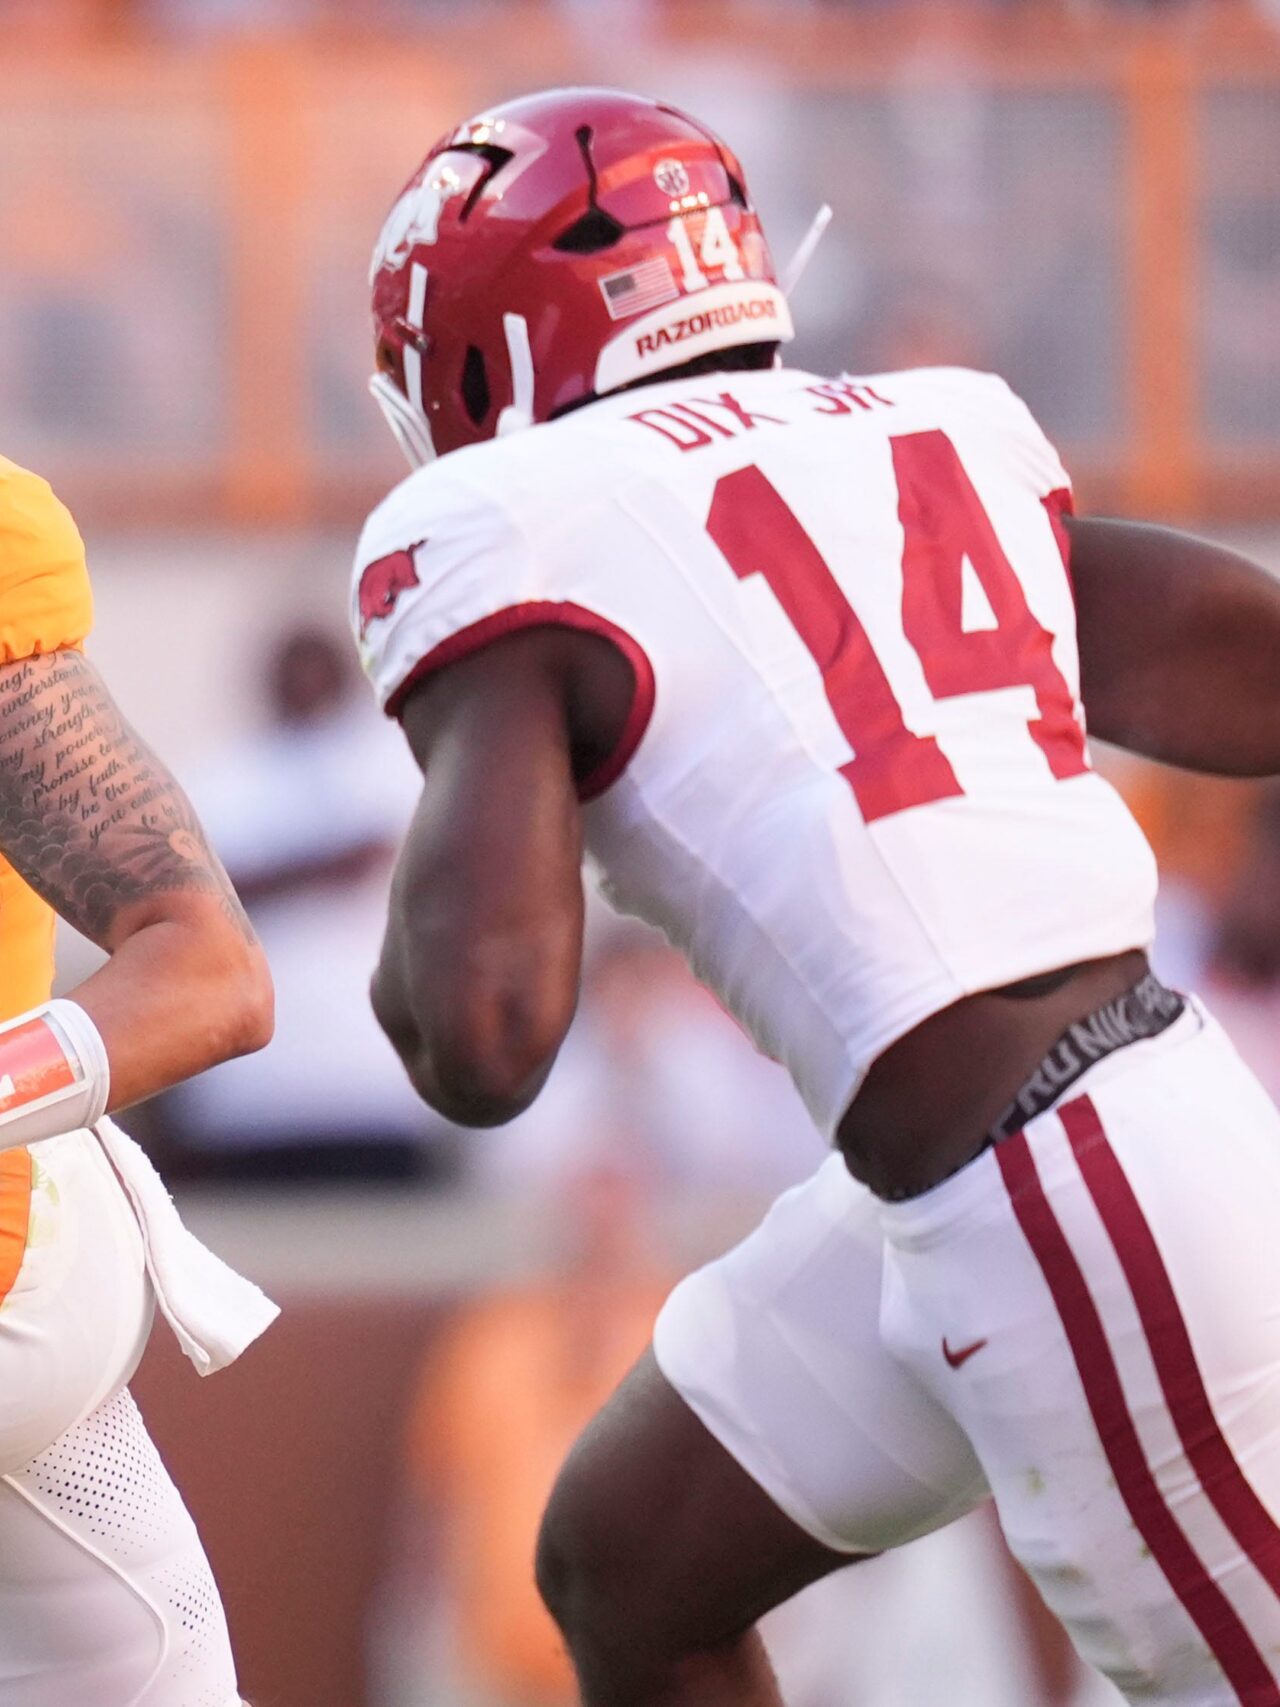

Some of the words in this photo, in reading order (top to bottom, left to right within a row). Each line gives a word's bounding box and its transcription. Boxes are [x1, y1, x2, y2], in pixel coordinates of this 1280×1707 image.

[666, 206, 745, 292] 14
[626, 393, 788, 452] DIX
[706, 428, 1093, 825] 14
[0, 748, 25, 773] my
[21, 761, 46, 789] my
[31, 755, 97, 808] promise
[58, 788, 81, 815] by
[80, 802, 101, 823] be
[105, 778, 131, 803] the
[89, 806, 127, 848] you
